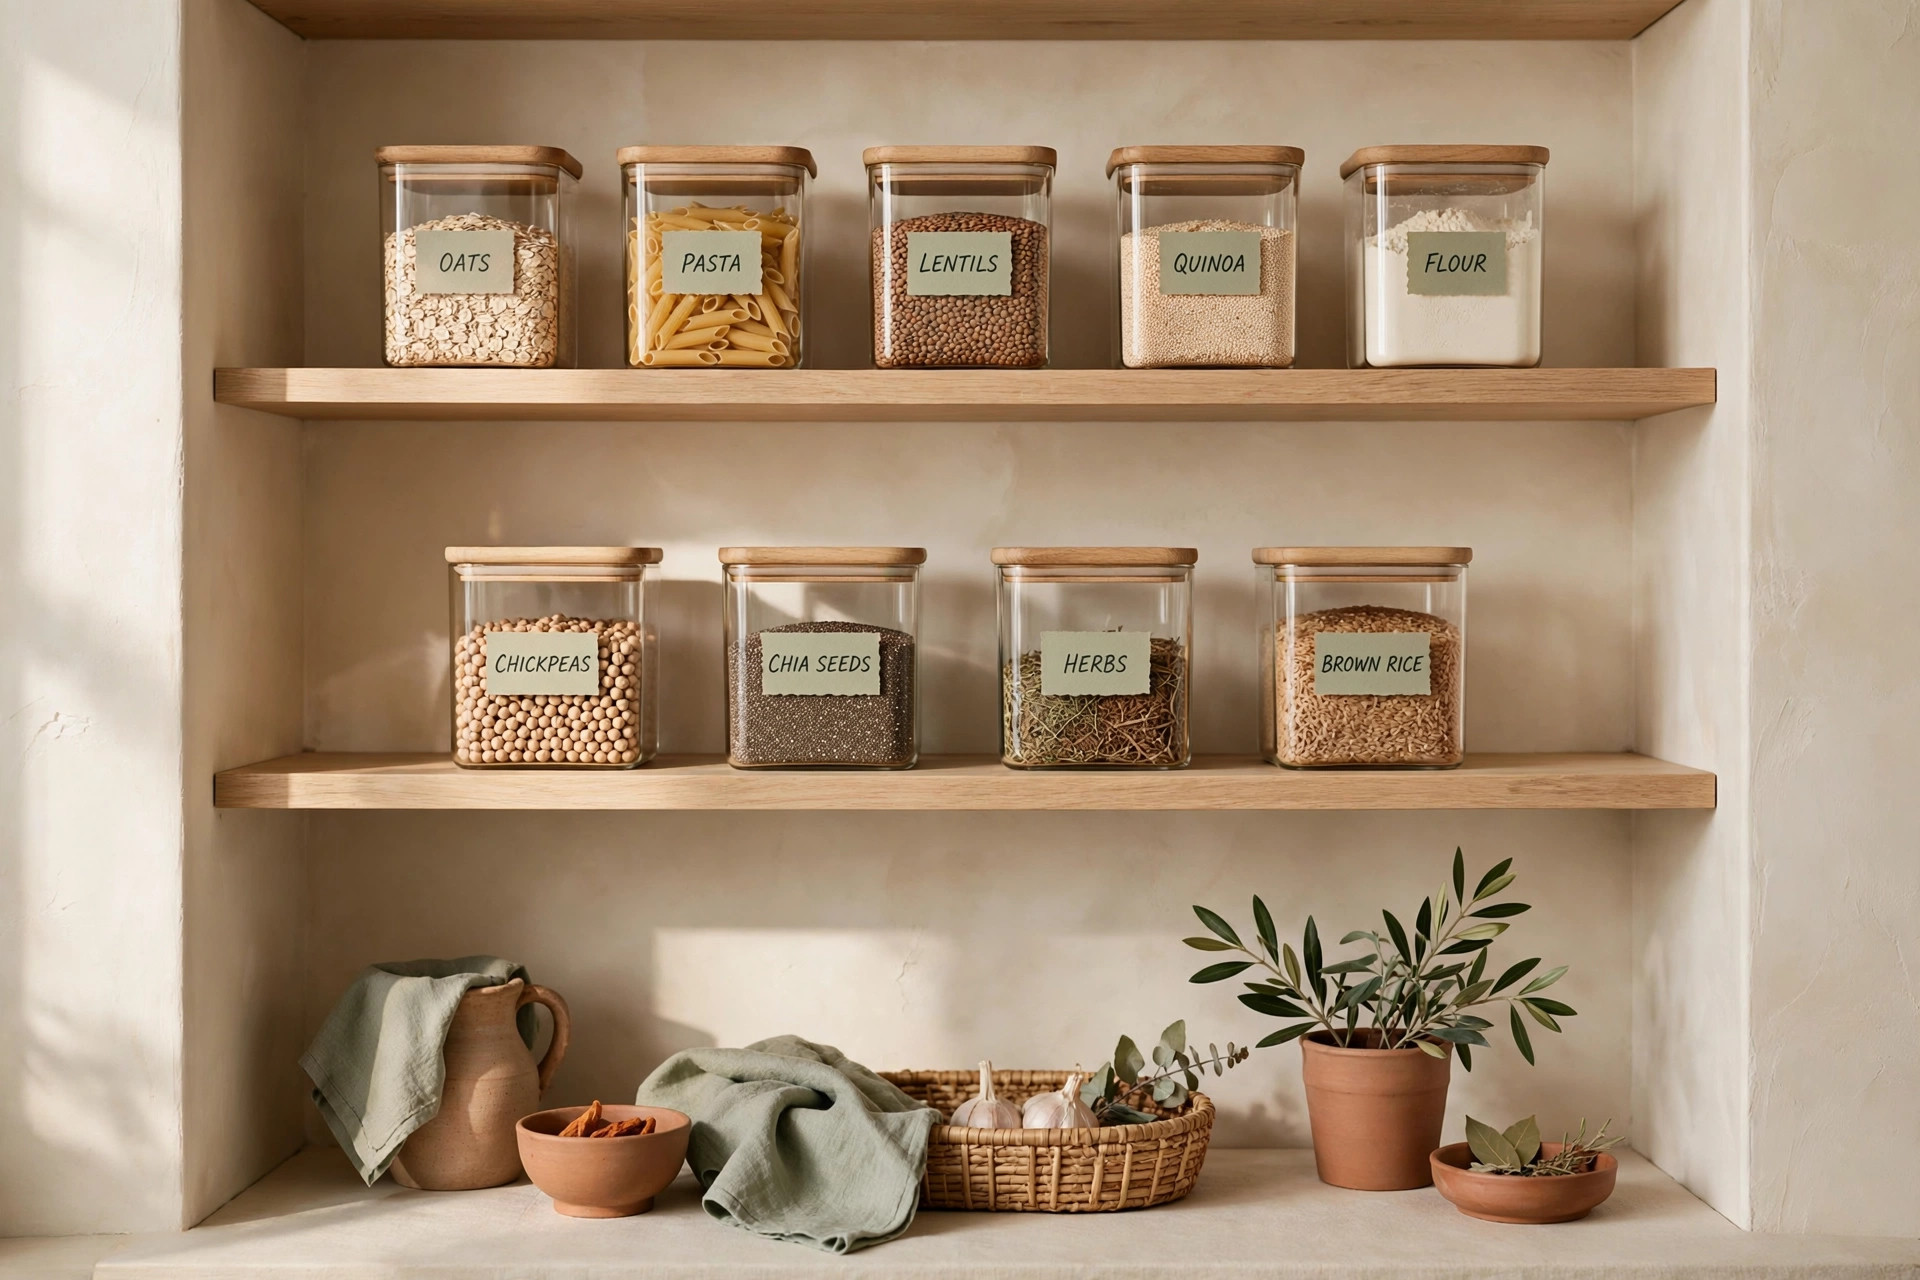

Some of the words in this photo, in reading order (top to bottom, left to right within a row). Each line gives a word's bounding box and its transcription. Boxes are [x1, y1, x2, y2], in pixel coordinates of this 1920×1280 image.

[439, 252, 491, 273] OATS
[681, 252, 741, 274] PASTA
[919, 252, 999, 273] LENTILS
[1173, 252, 1245, 275] QUINOA
[1424, 252, 1487, 273] FLOUR
[494, 653, 592, 674] CHICKPEAS
[768, 653, 809, 674] CHIA
[815, 655, 873, 673] SEEDS
[1063, 653, 1128, 674] HERBS
[1321, 654, 1382, 674] BROWN
[1386, 655, 1425, 673] RICE
